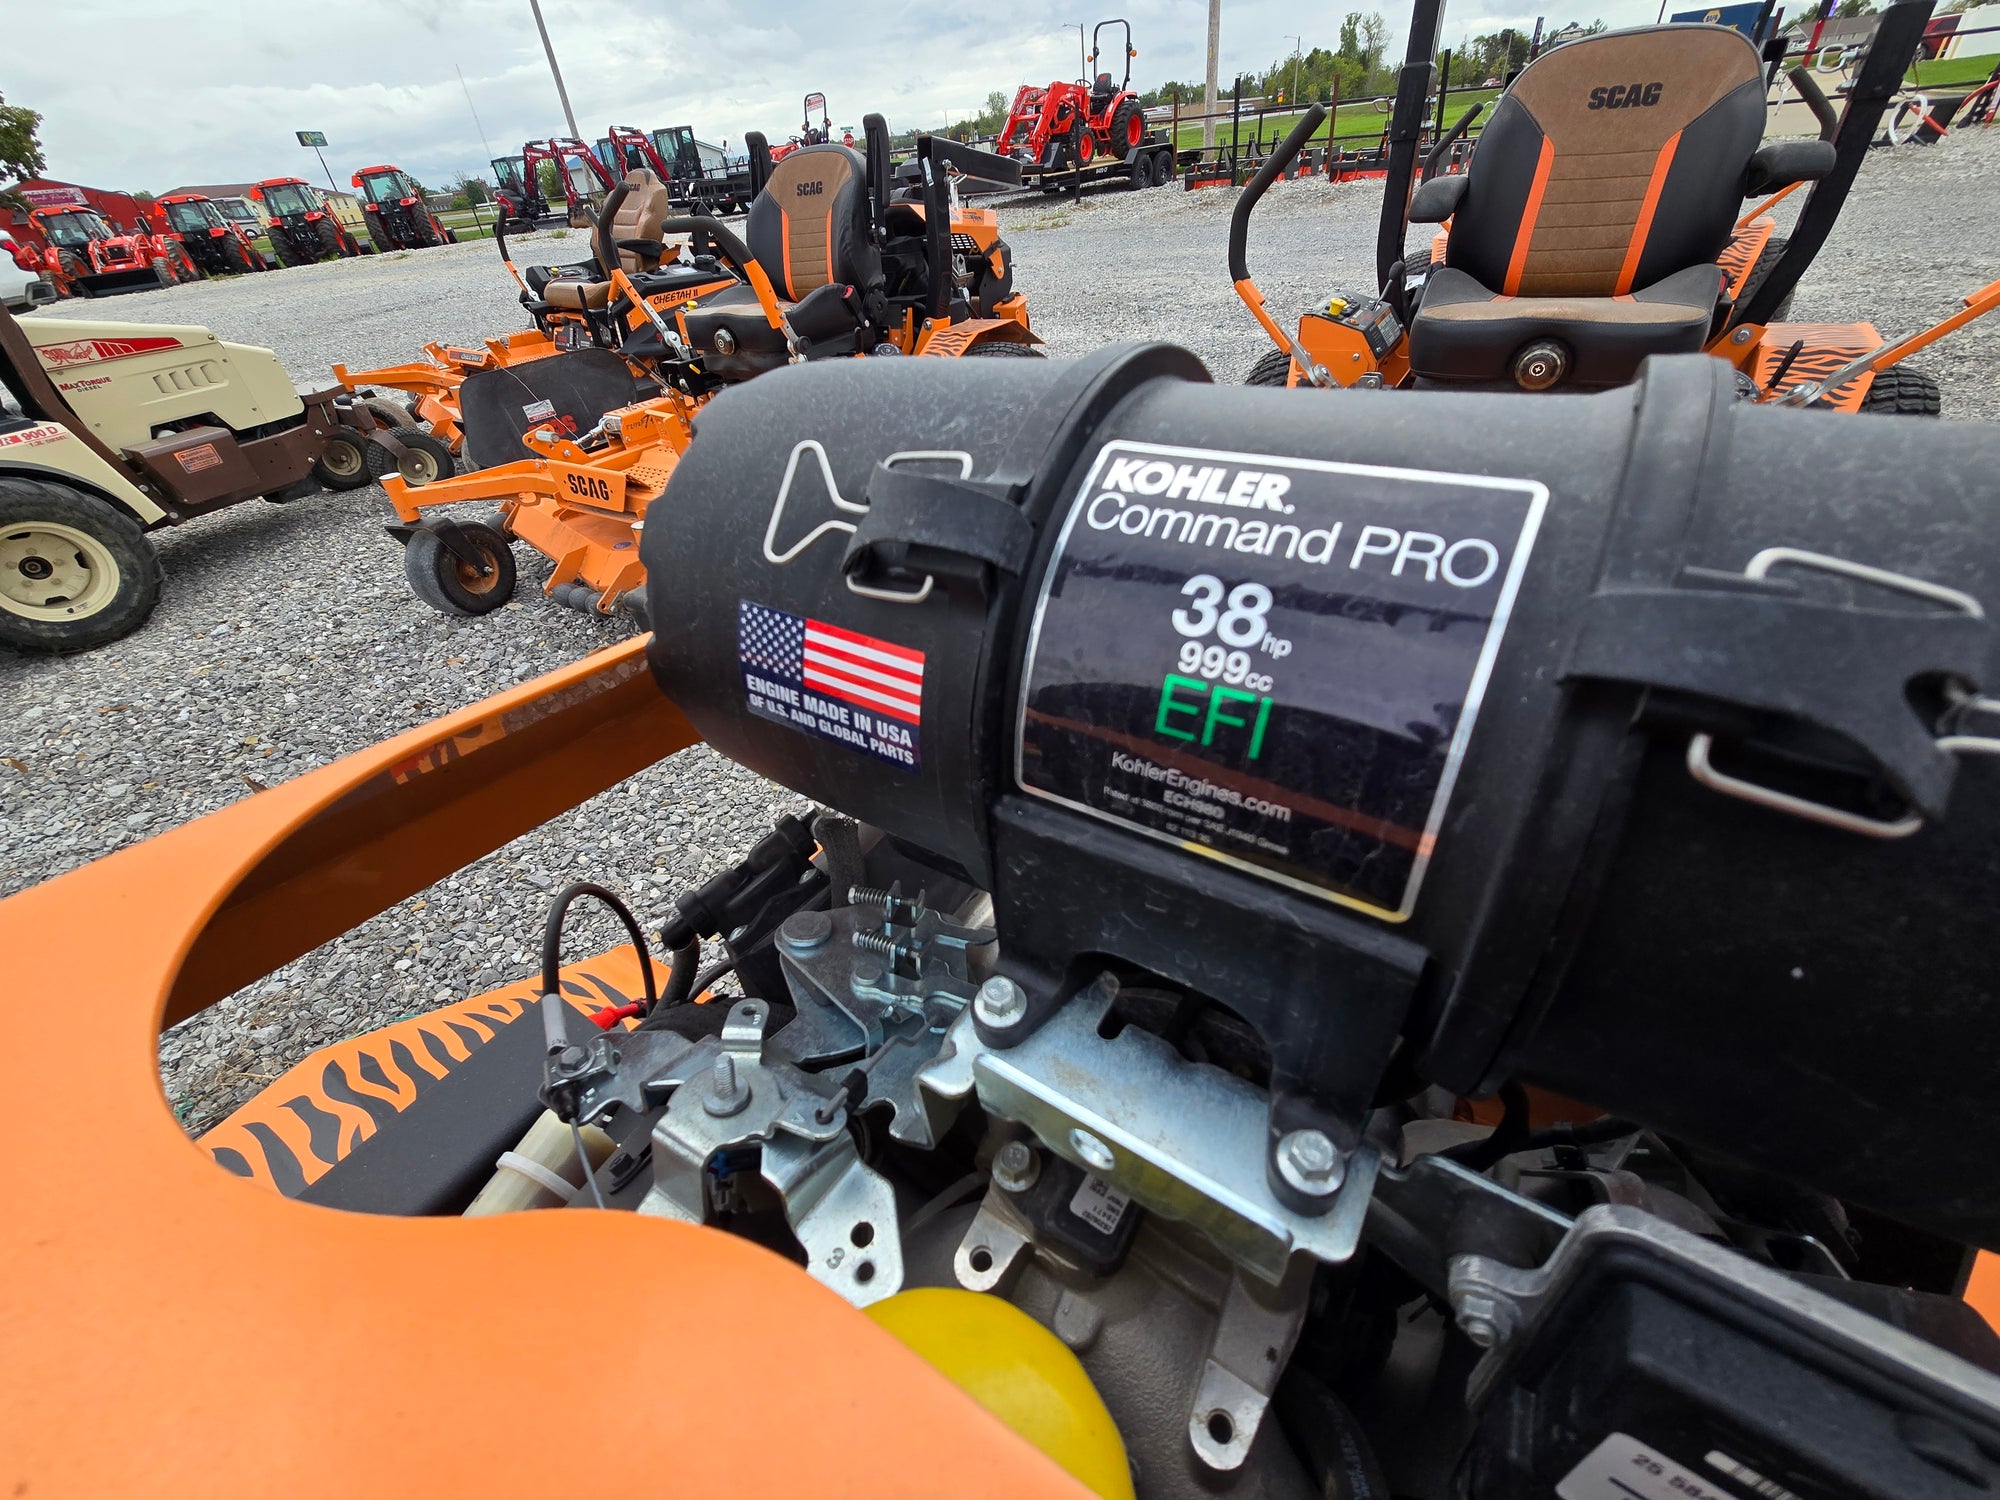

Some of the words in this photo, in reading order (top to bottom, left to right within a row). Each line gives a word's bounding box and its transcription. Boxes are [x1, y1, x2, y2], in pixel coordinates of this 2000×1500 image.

[1588, 82, 1664, 110] SCAG
[796, 181, 823, 197] SCAG
[653, 290, 692, 305] CHEETAH
[77, 385, 103, 393] DIESEL
[45, 426, 59, 435] D
[567, 473, 610, 501] SCAG
[1086, 491, 1342, 565] Command
[1349, 525, 1499, 588] PRO
[745, 673, 801, 706] ENGINE
[803, 693, 850, 725] MADE
[854, 711, 872, 734] IN
[876, 719, 913, 748] USA
[1154, 673, 1274, 760] EFI
[749, 693, 765, 709] OF
[767, 699, 790, 718] U.S.
[791, 709, 817, 729] AND
[818, 719, 868, 750] GLOBAL
[869, 737, 914, 766] PARTS
[1111, 751, 1292, 822] KohlerEngines.com
